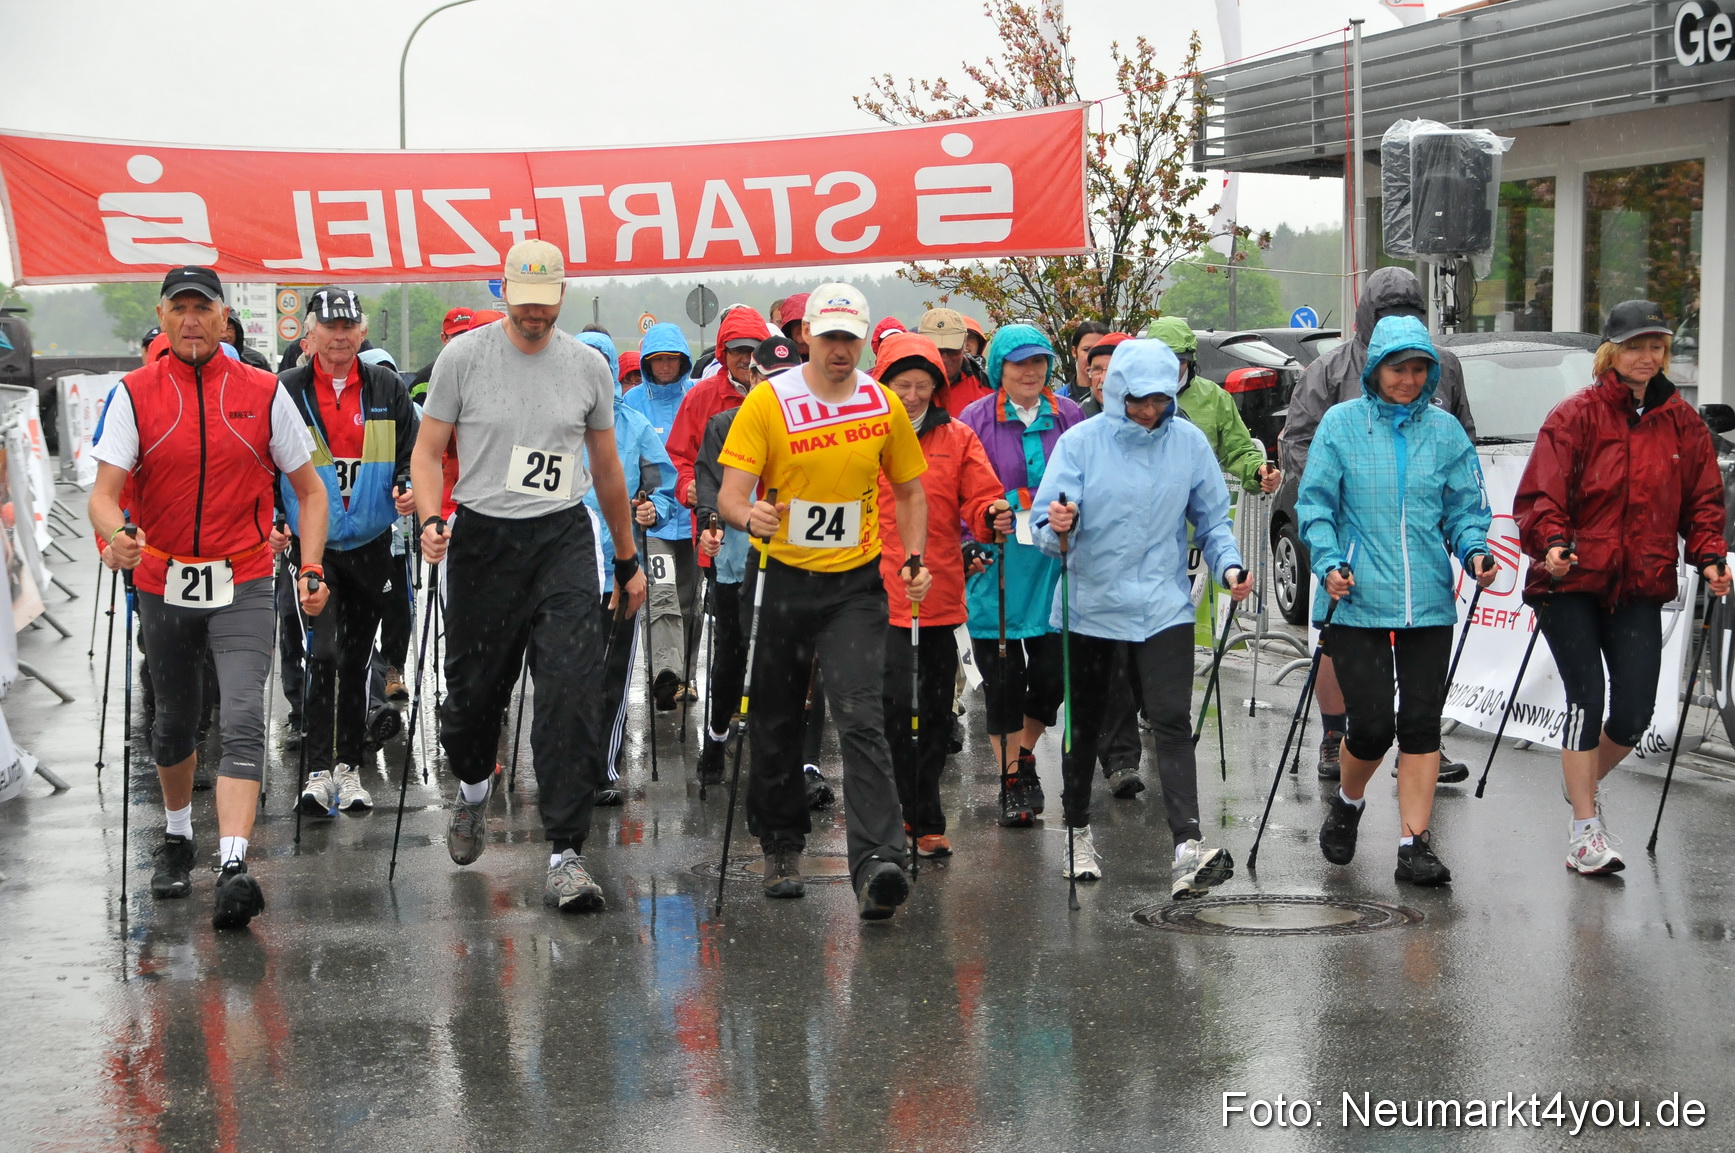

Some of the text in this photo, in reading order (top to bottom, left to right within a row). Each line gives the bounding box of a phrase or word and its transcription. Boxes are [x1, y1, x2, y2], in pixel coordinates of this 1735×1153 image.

[1674, 1, 1733, 67] Ge
[282, 296, 296, 308] 60
[642, 319, 654, 330] 60
[789, 422, 891, 455] MAX BÖGL
[522, 451, 563, 492] 25
[805, 505, 845, 542] 24
[181, 565, 213, 602] 21
[651, 555, 667, 580] 8
[1471, 606, 1521, 631] SEAT
